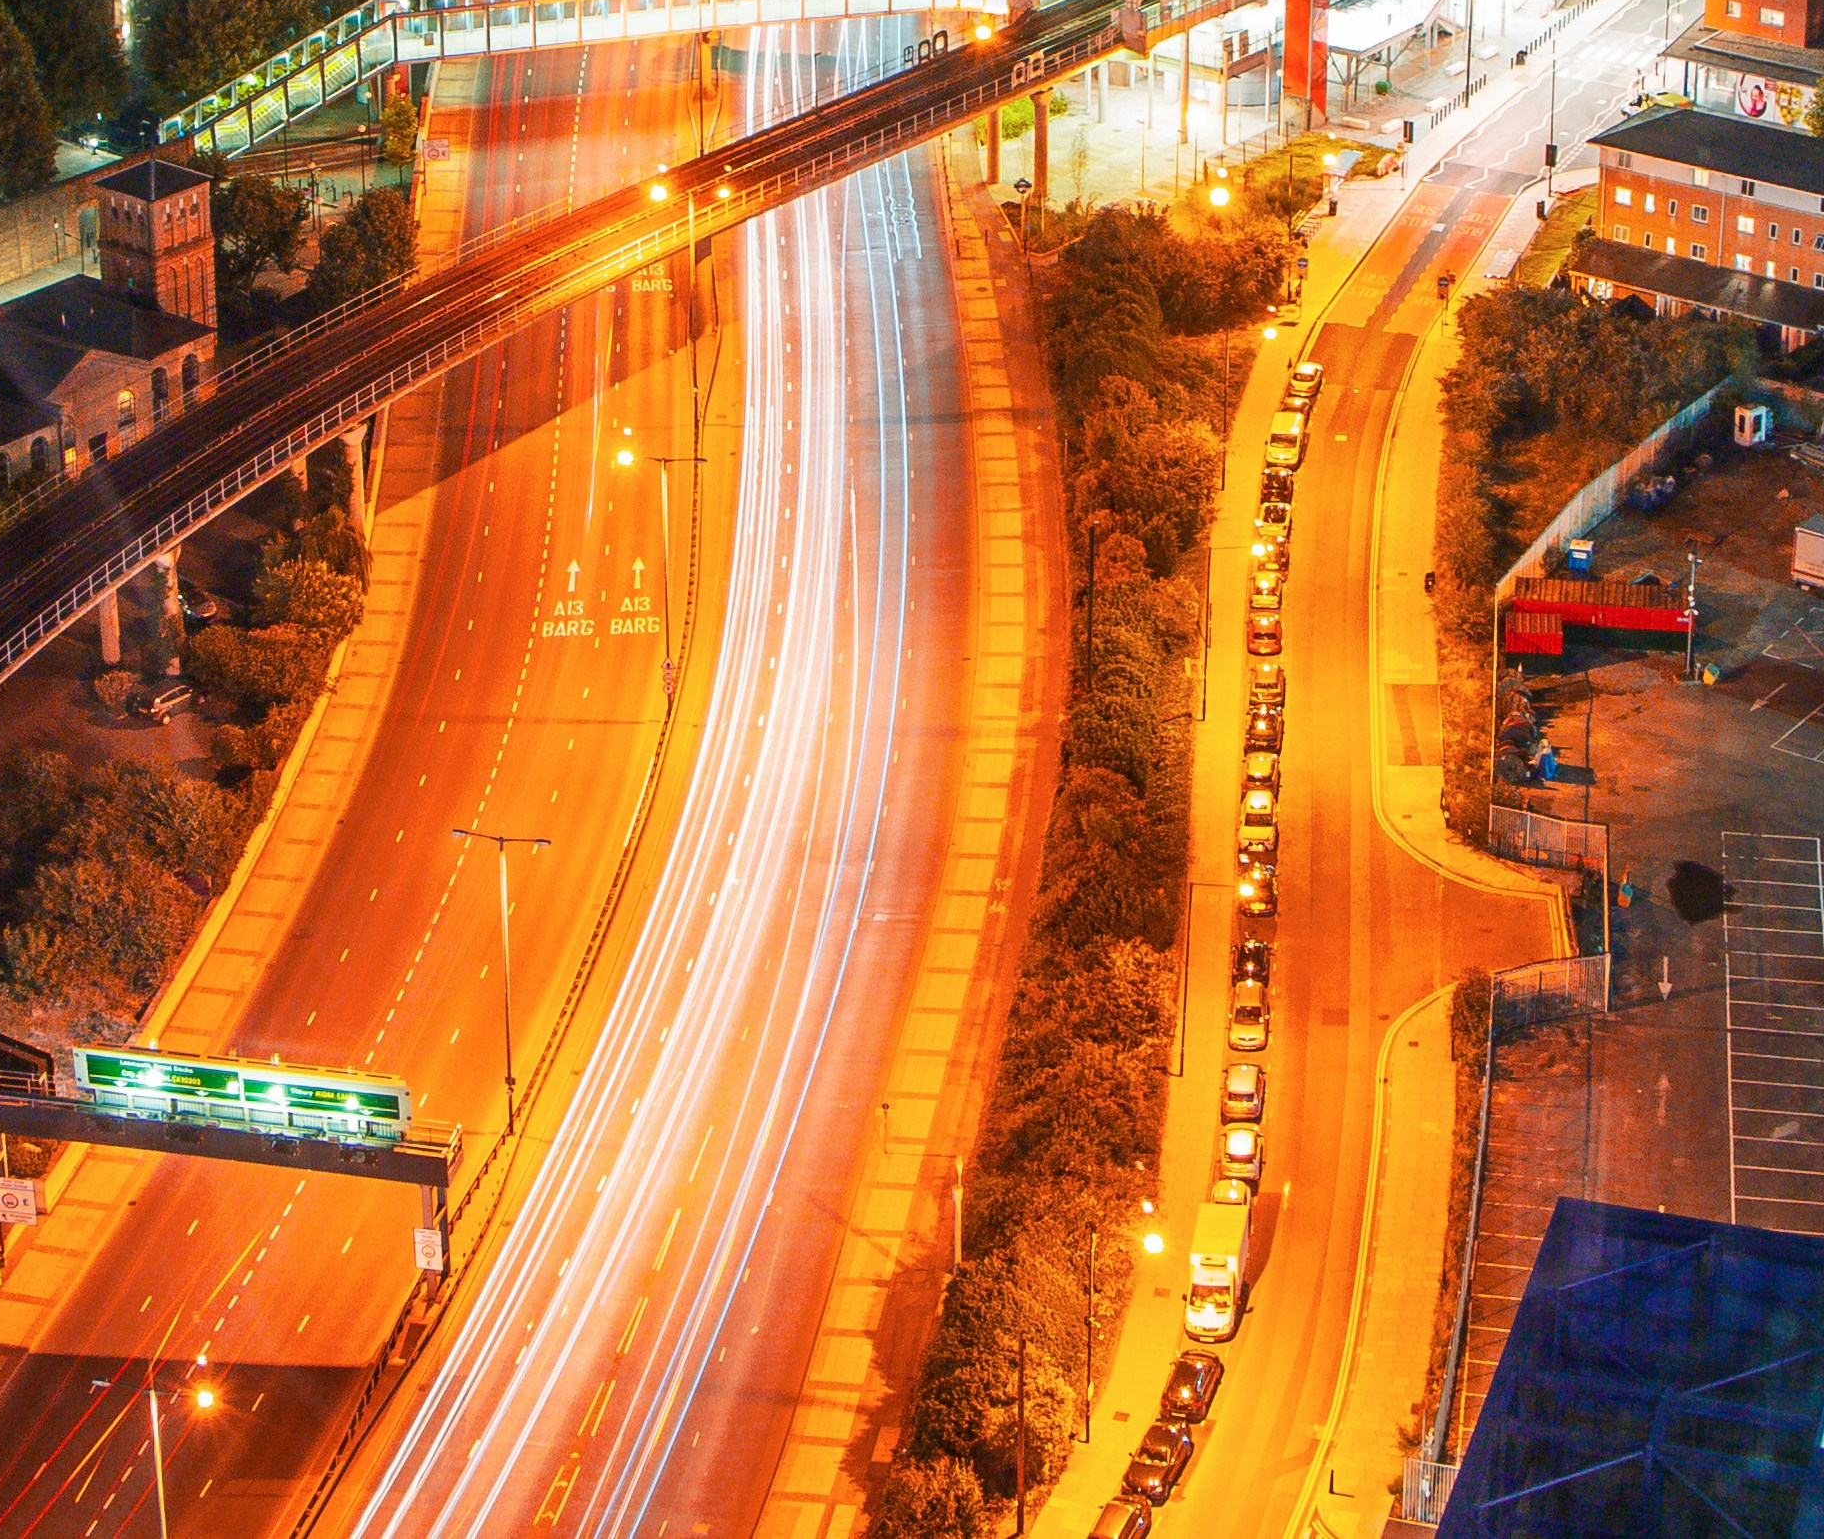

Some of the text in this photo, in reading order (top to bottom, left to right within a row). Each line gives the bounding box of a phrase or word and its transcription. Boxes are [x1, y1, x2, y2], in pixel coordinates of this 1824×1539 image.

[1411, 205, 1438, 215] BUS
[1400, 216, 1434, 227] STOP
[553, 600, 584, 616] A13
[621, 597, 651, 612] A13
